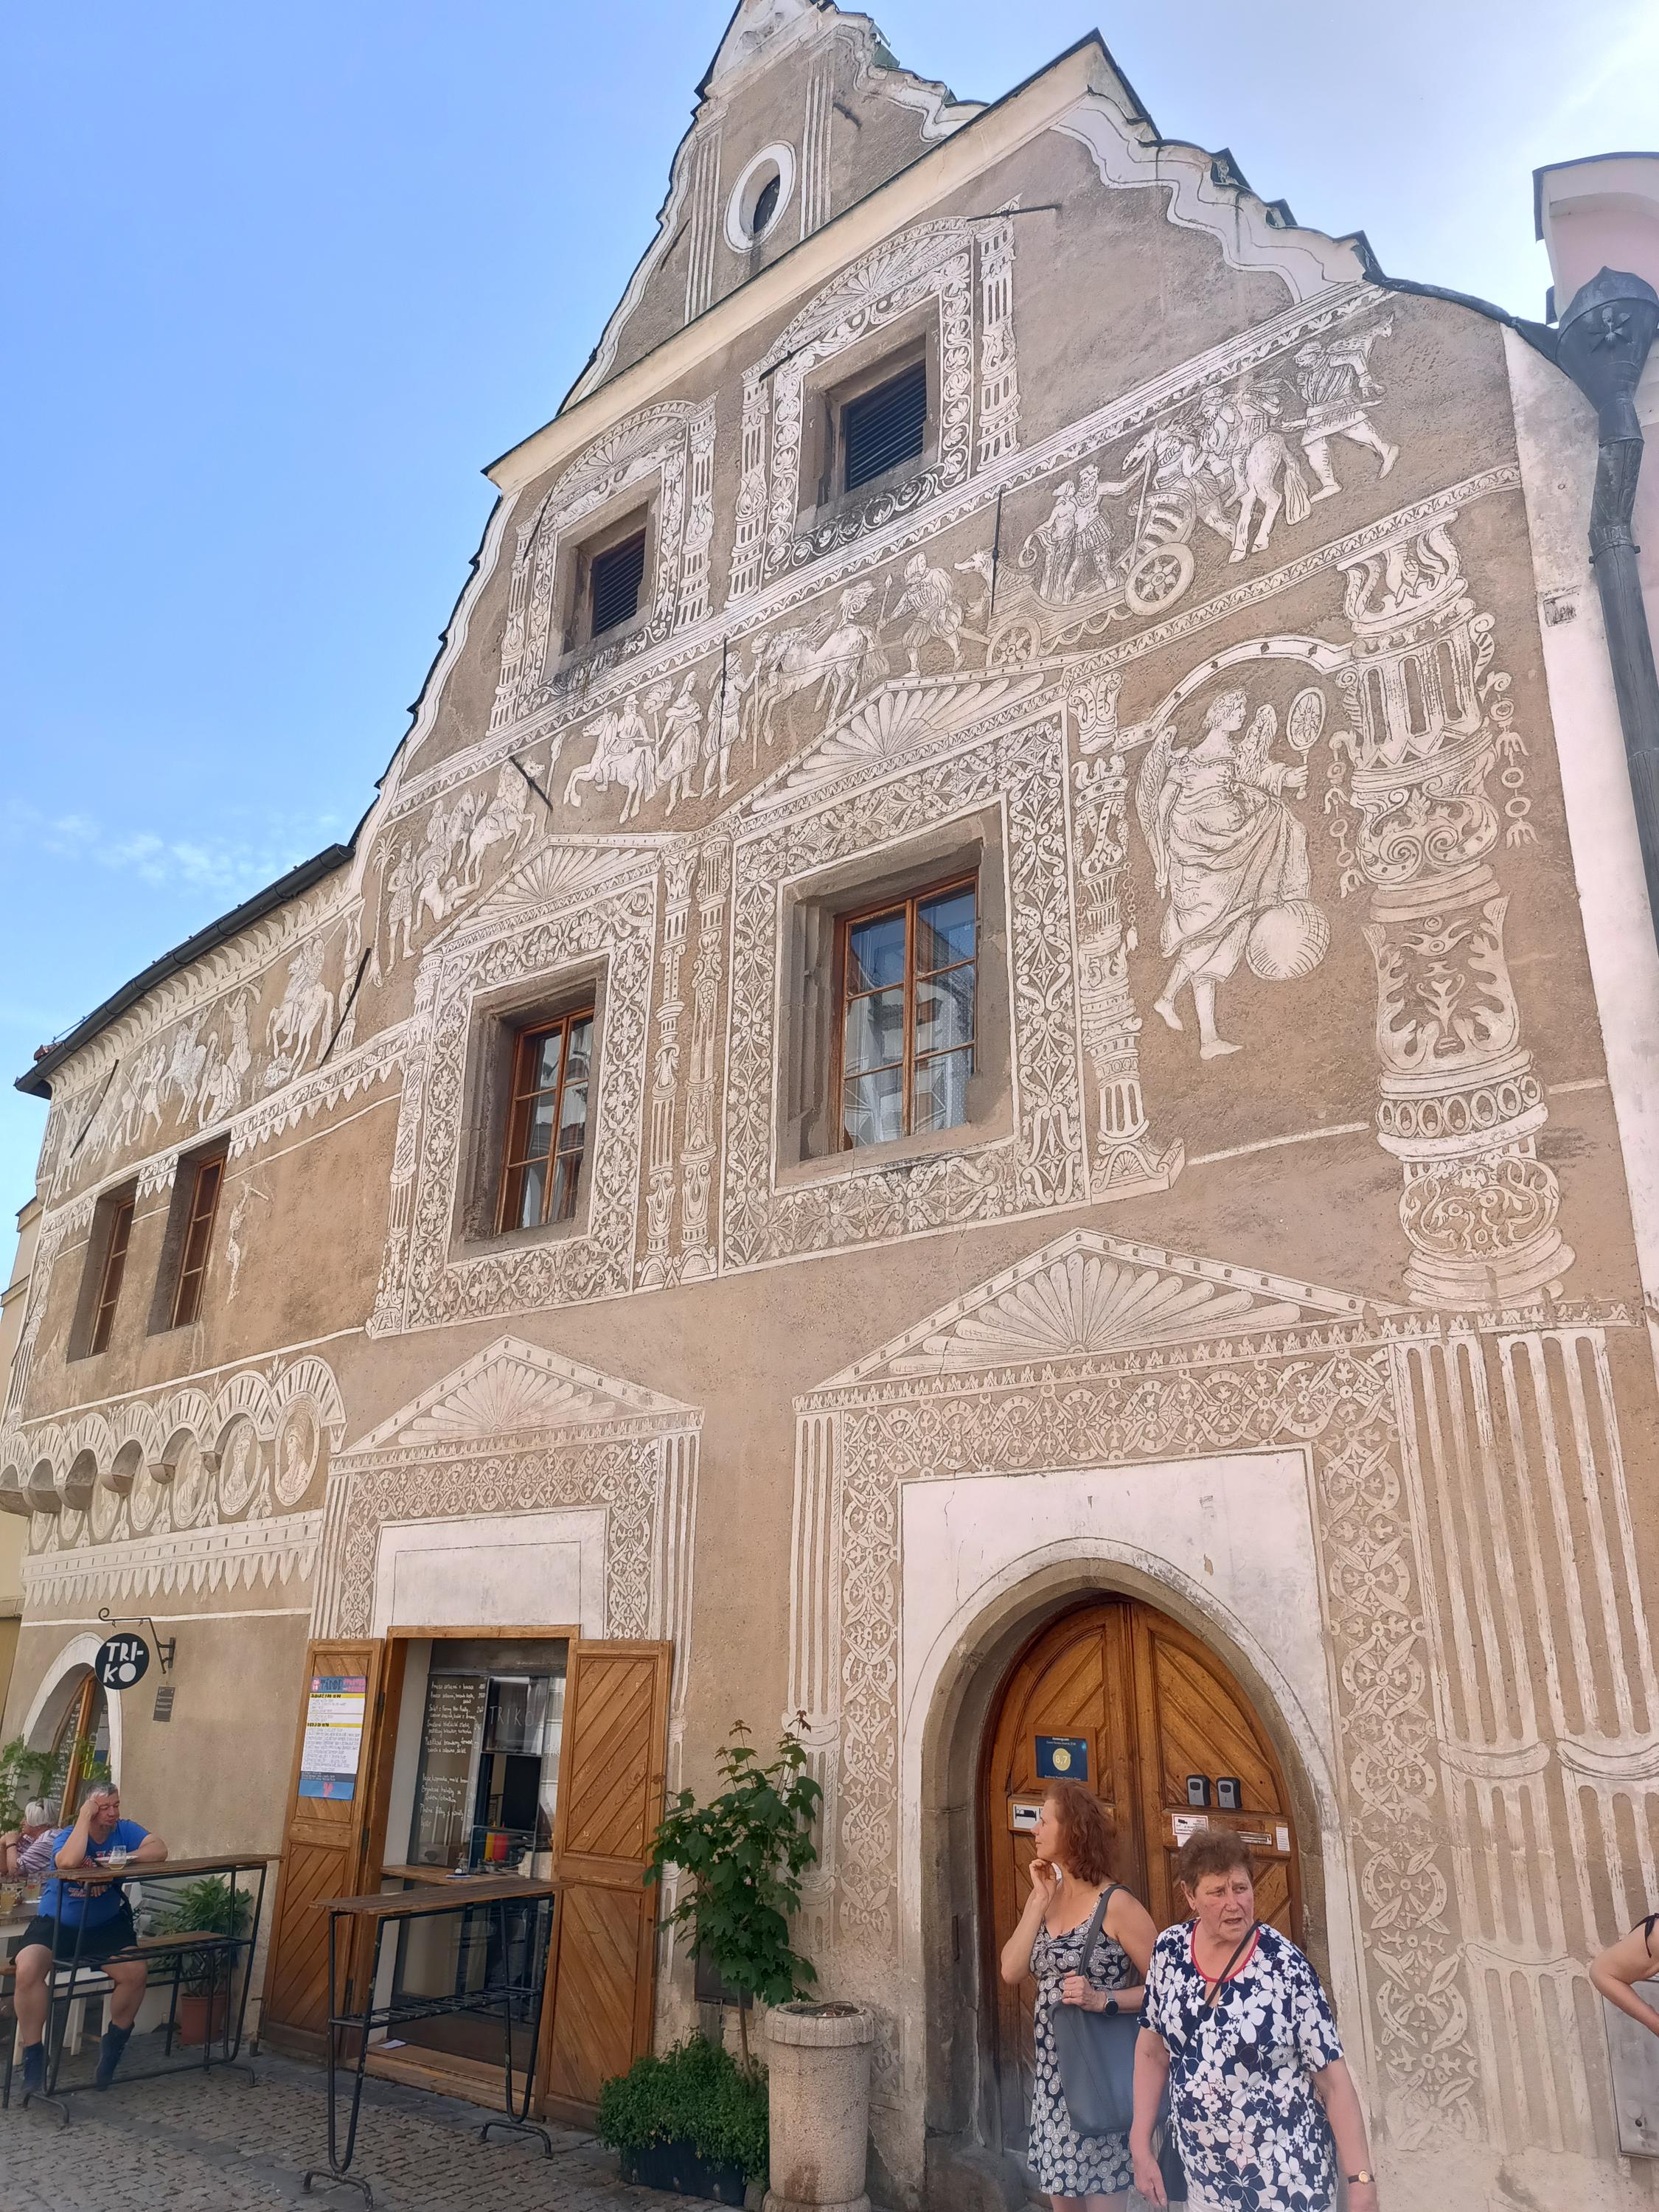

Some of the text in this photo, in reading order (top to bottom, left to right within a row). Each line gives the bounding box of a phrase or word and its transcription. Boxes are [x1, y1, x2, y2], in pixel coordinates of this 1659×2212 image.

[106, 1641, 144, 1662] TRI-
[103, 1663, 136, 1683] KO
[490, 1705, 534, 1727] TRIKO
[1055, 1755, 1068, 1764] 8,7
